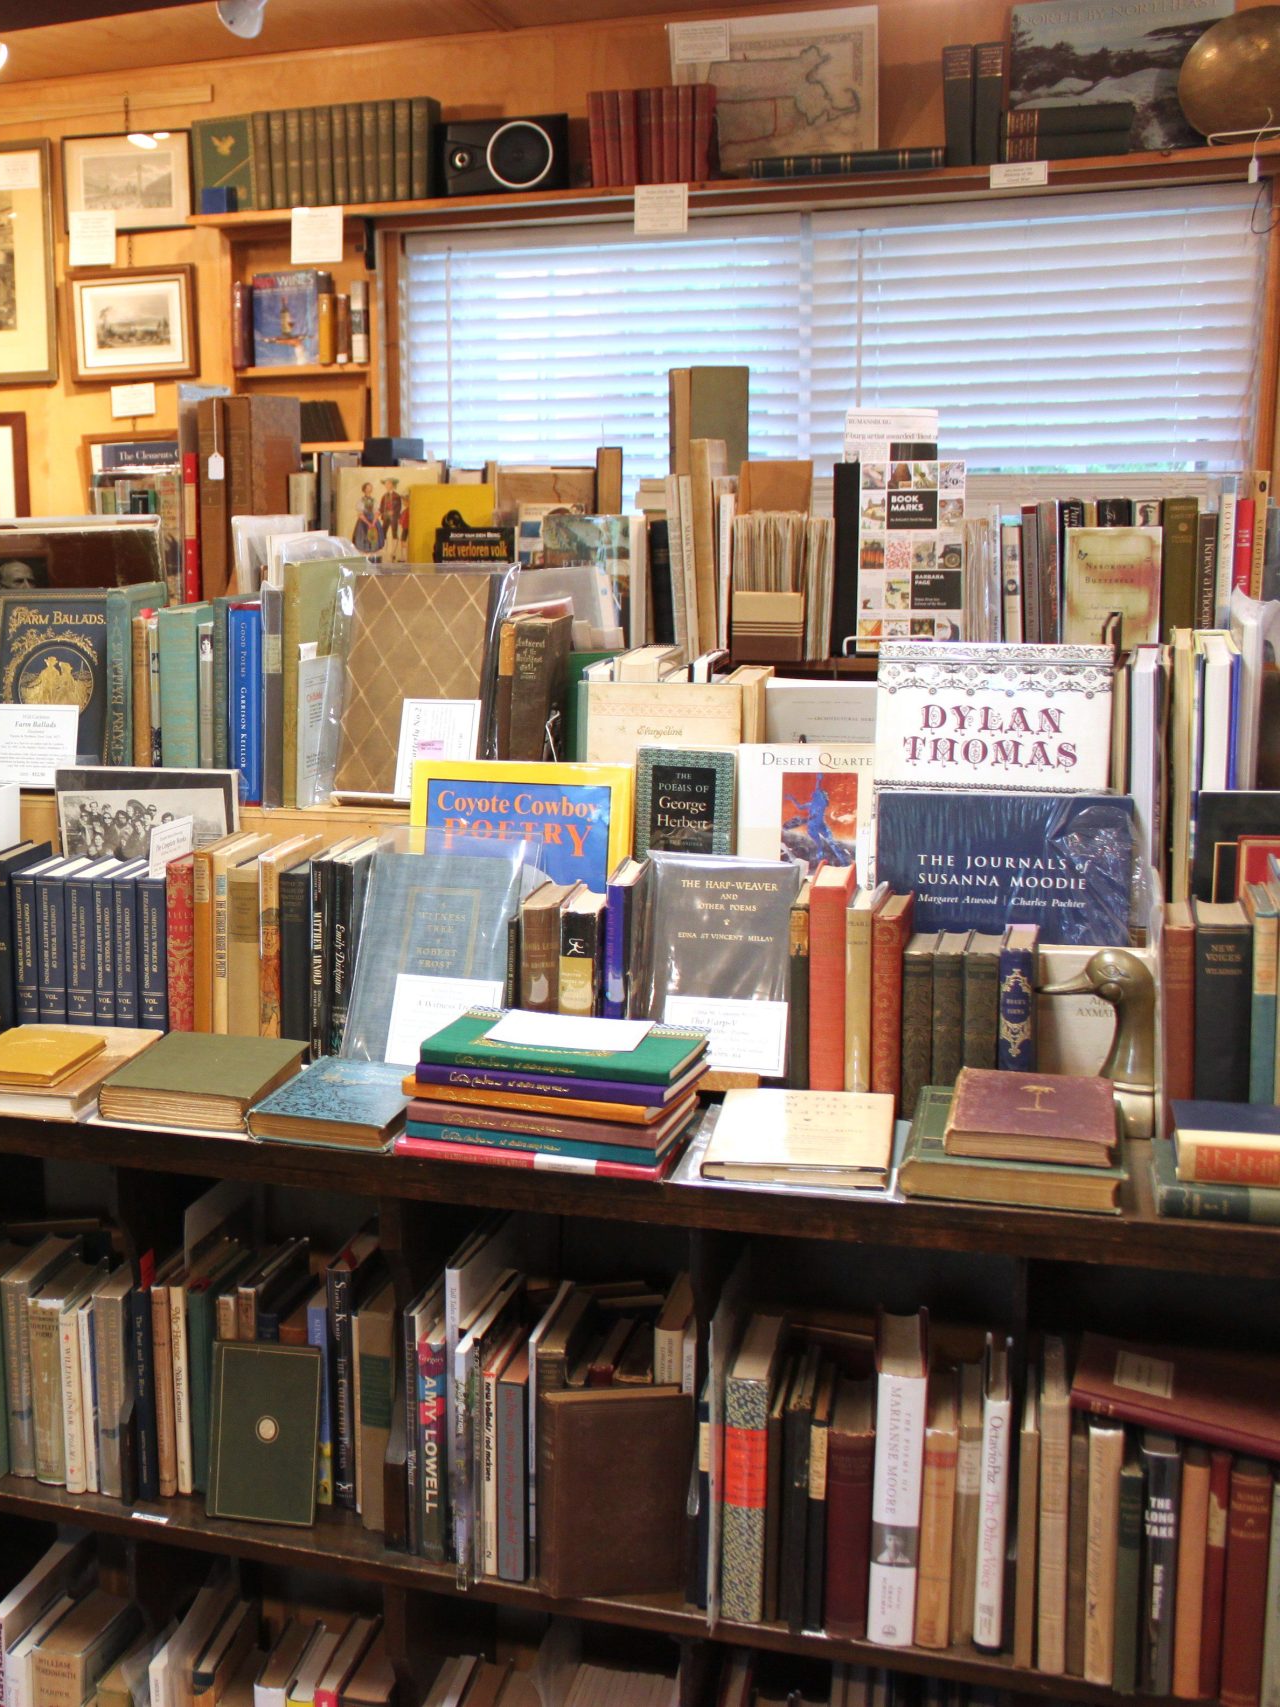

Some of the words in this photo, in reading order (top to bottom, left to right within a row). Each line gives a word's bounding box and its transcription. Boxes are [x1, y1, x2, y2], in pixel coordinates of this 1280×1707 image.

[120, 452, 134, 461] The
[135, 450, 173, 460] Clements
[891, 495, 919, 504] BOOK
[891, 504, 924, 512] MARKS
[442, 542, 456, 557] Het
[457, 542, 490, 557] verloren
[490, 541, 508, 557] volk
[15, 611, 49, 625] FARM
[51, 610, 107, 626] BALLADS.
[112, 642, 124, 705] BALLADS
[32, 721, 57, 729] Ballads
[919, 703, 1067, 736] DYLAN
[112, 712, 124, 751] FARM
[761, 751, 813, 766] DESERT
[817, 751, 873, 770] QUARTE
[903, 735, 1079, 774] THOMAS
[658, 781, 692, 792] POEMS
[695, 784, 710, 793] OF
[676, 772, 692, 780] THE
[437, 790, 511, 814] Coyote
[513, 790, 598, 823] Cowboy
[658, 796, 707, 814] George
[657, 812, 709, 830] Herbert
[443, 817, 593, 857] POETRY
[917, 853, 956, 868] THE
[966, 855, 1067, 871] JOURNALS
[1075, 859, 1091, 873] of
[680, 879, 701, 889] THE
[705, 880, 779, 892] HARP-WEAVER
[917, 873, 999, 887] SUSANNA
[1010, 876, 1087, 891] MOODIE
[698, 902, 725, 911] OTHER
[729, 904, 758, 912] POEMS
[917, 893, 959, 906] Margaret
[963, 894, 998, 905] Atwood
[1011, 896, 1047, 907] Charles
[1050, 897, 1086, 909] Pachter
[313, 911, 322, 952] MATTHEW
[335, 923, 346, 950] Emily
[710, 933, 744, 941] VINCENT
[1204, 953, 1242, 963] VOICES
[1210, 944, 1236, 952] NEW
[313, 955, 322, 986] ARNOLD
[333, 950, 346, 995] Dickinson
[173, 1327, 182, 1361] House
[64, 1347, 73, 1388] WILLIAM
[175, 1366, 183, 1389] Nikki
[406, 1341, 415, 1395] DONALD
[176, 1390, 184, 1424] Giovanni
[424, 1375, 438, 1425] AMY
[485, 1401, 493, 1432] ballads
[886, 1386, 902, 1463] MARIANNE
[989, 1416, 1003, 1463] Octavio
[407, 1449, 417, 1486] Without
[424, 1429, 439, 1514] LOWELL
[987, 1464, 1001, 1484] Paz
[884, 1465, 898, 1515] MOORE
[986, 1491, 999, 1513] The
[1149, 1497, 1171, 1510] THE
[1144, 1510, 1175, 1524] LONG
[984, 1515, 999, 1556] Other
[1145, 1524, 1175, 1538] TAKE
[981, 1558, 995, 1588] Voice
